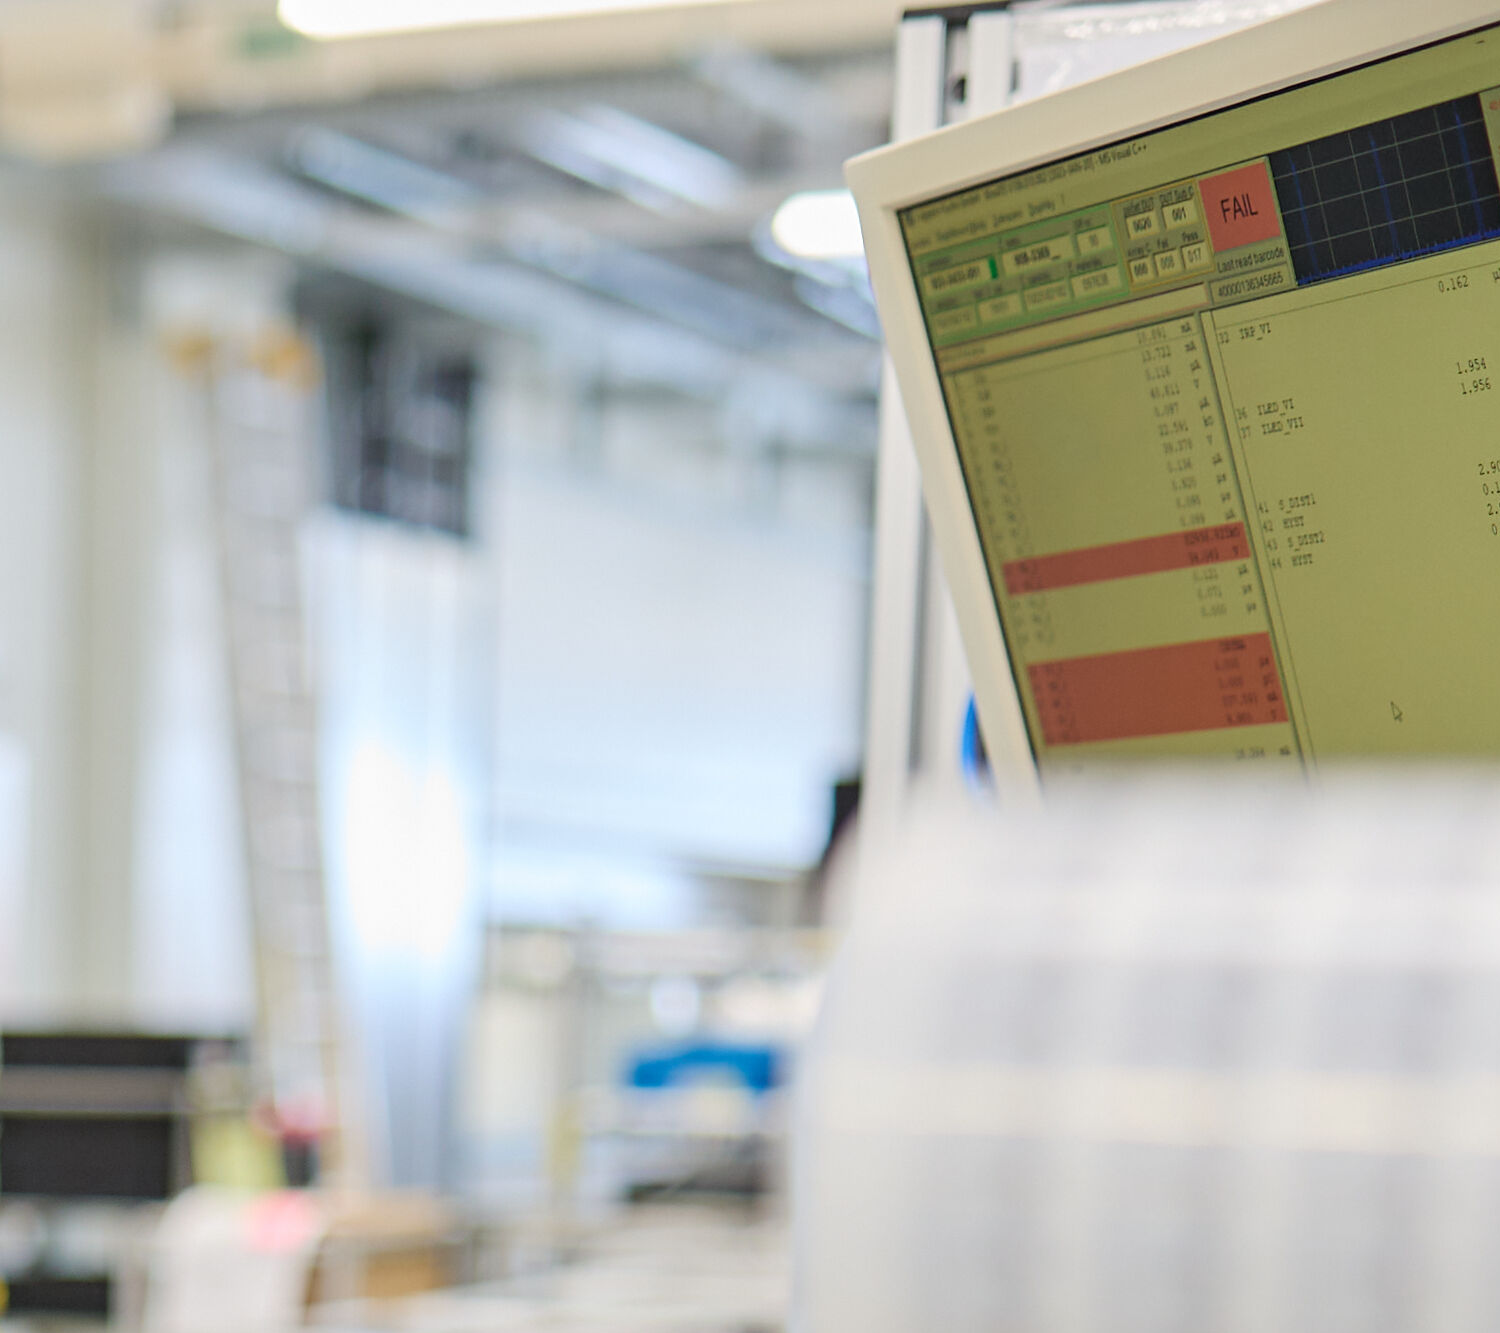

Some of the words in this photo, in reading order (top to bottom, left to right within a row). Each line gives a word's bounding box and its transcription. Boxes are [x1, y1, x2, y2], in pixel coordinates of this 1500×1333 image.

[1220, 193, 1258, 223] FAIL
[1438, 274, 1469, 293] 0.162
[1456, 357, 1487, 374] 1.954
[1461, 377, 1491, 395] 1.956
